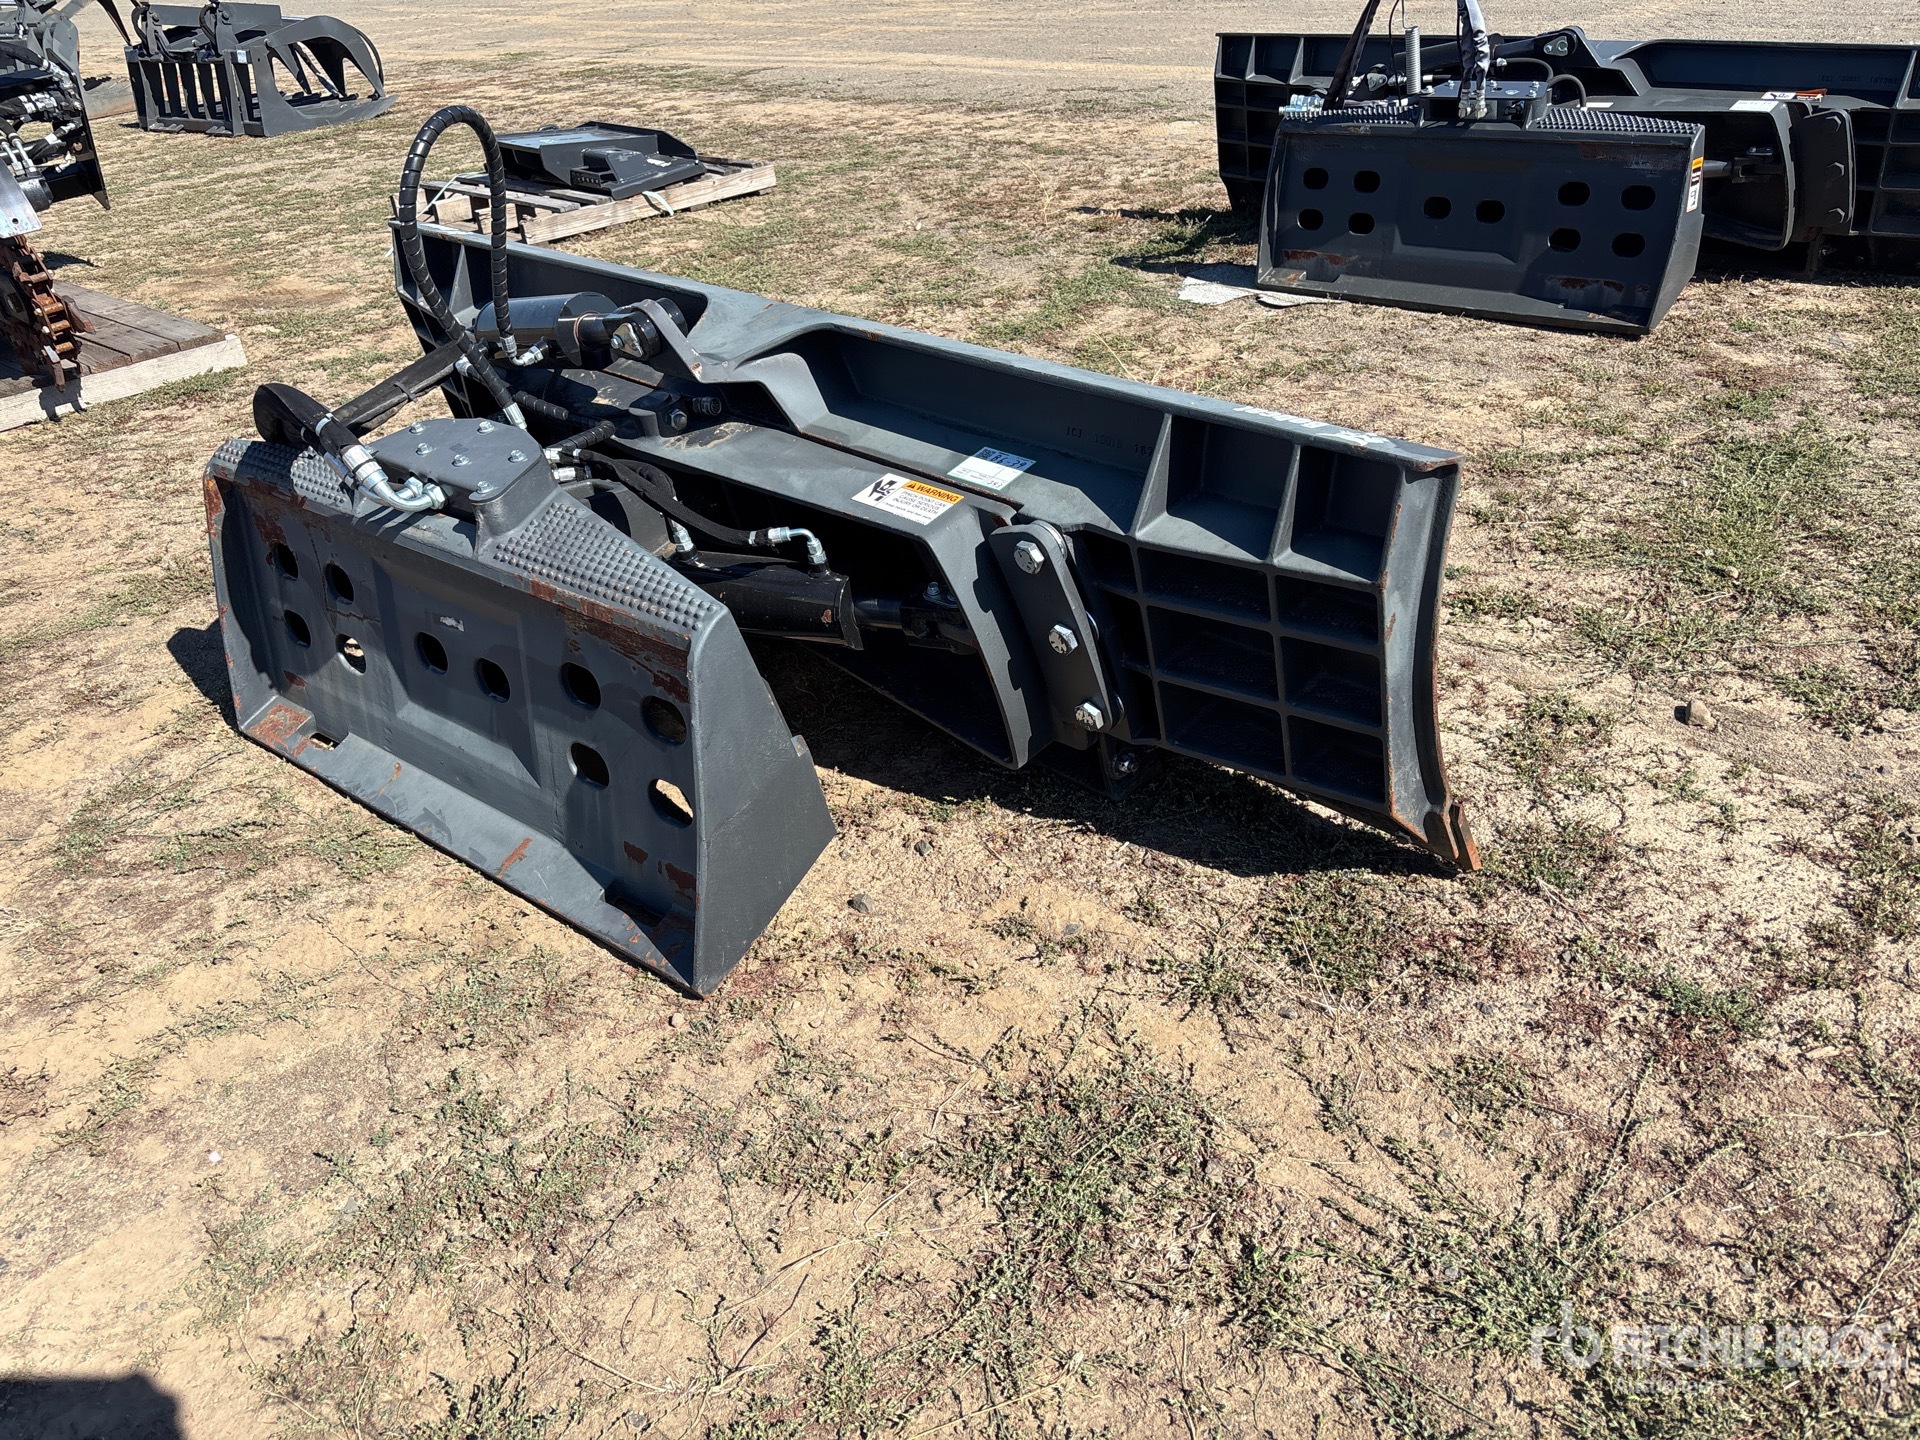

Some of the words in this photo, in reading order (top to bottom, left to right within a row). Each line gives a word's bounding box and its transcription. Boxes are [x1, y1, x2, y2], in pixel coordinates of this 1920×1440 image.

[898, 495, 915, 503] CAUSE
[917, 500, 940, 510] SERIOUS
[901, 490, 917, 498] PINCH
[918, 495, 934, 503] POINT
[934, 500, 947, 508] CAN
[916, 485, 959, 503] WARNING
[892, 498, 910, 507] INJURY
[919, 505, 939, 515] DEATH
